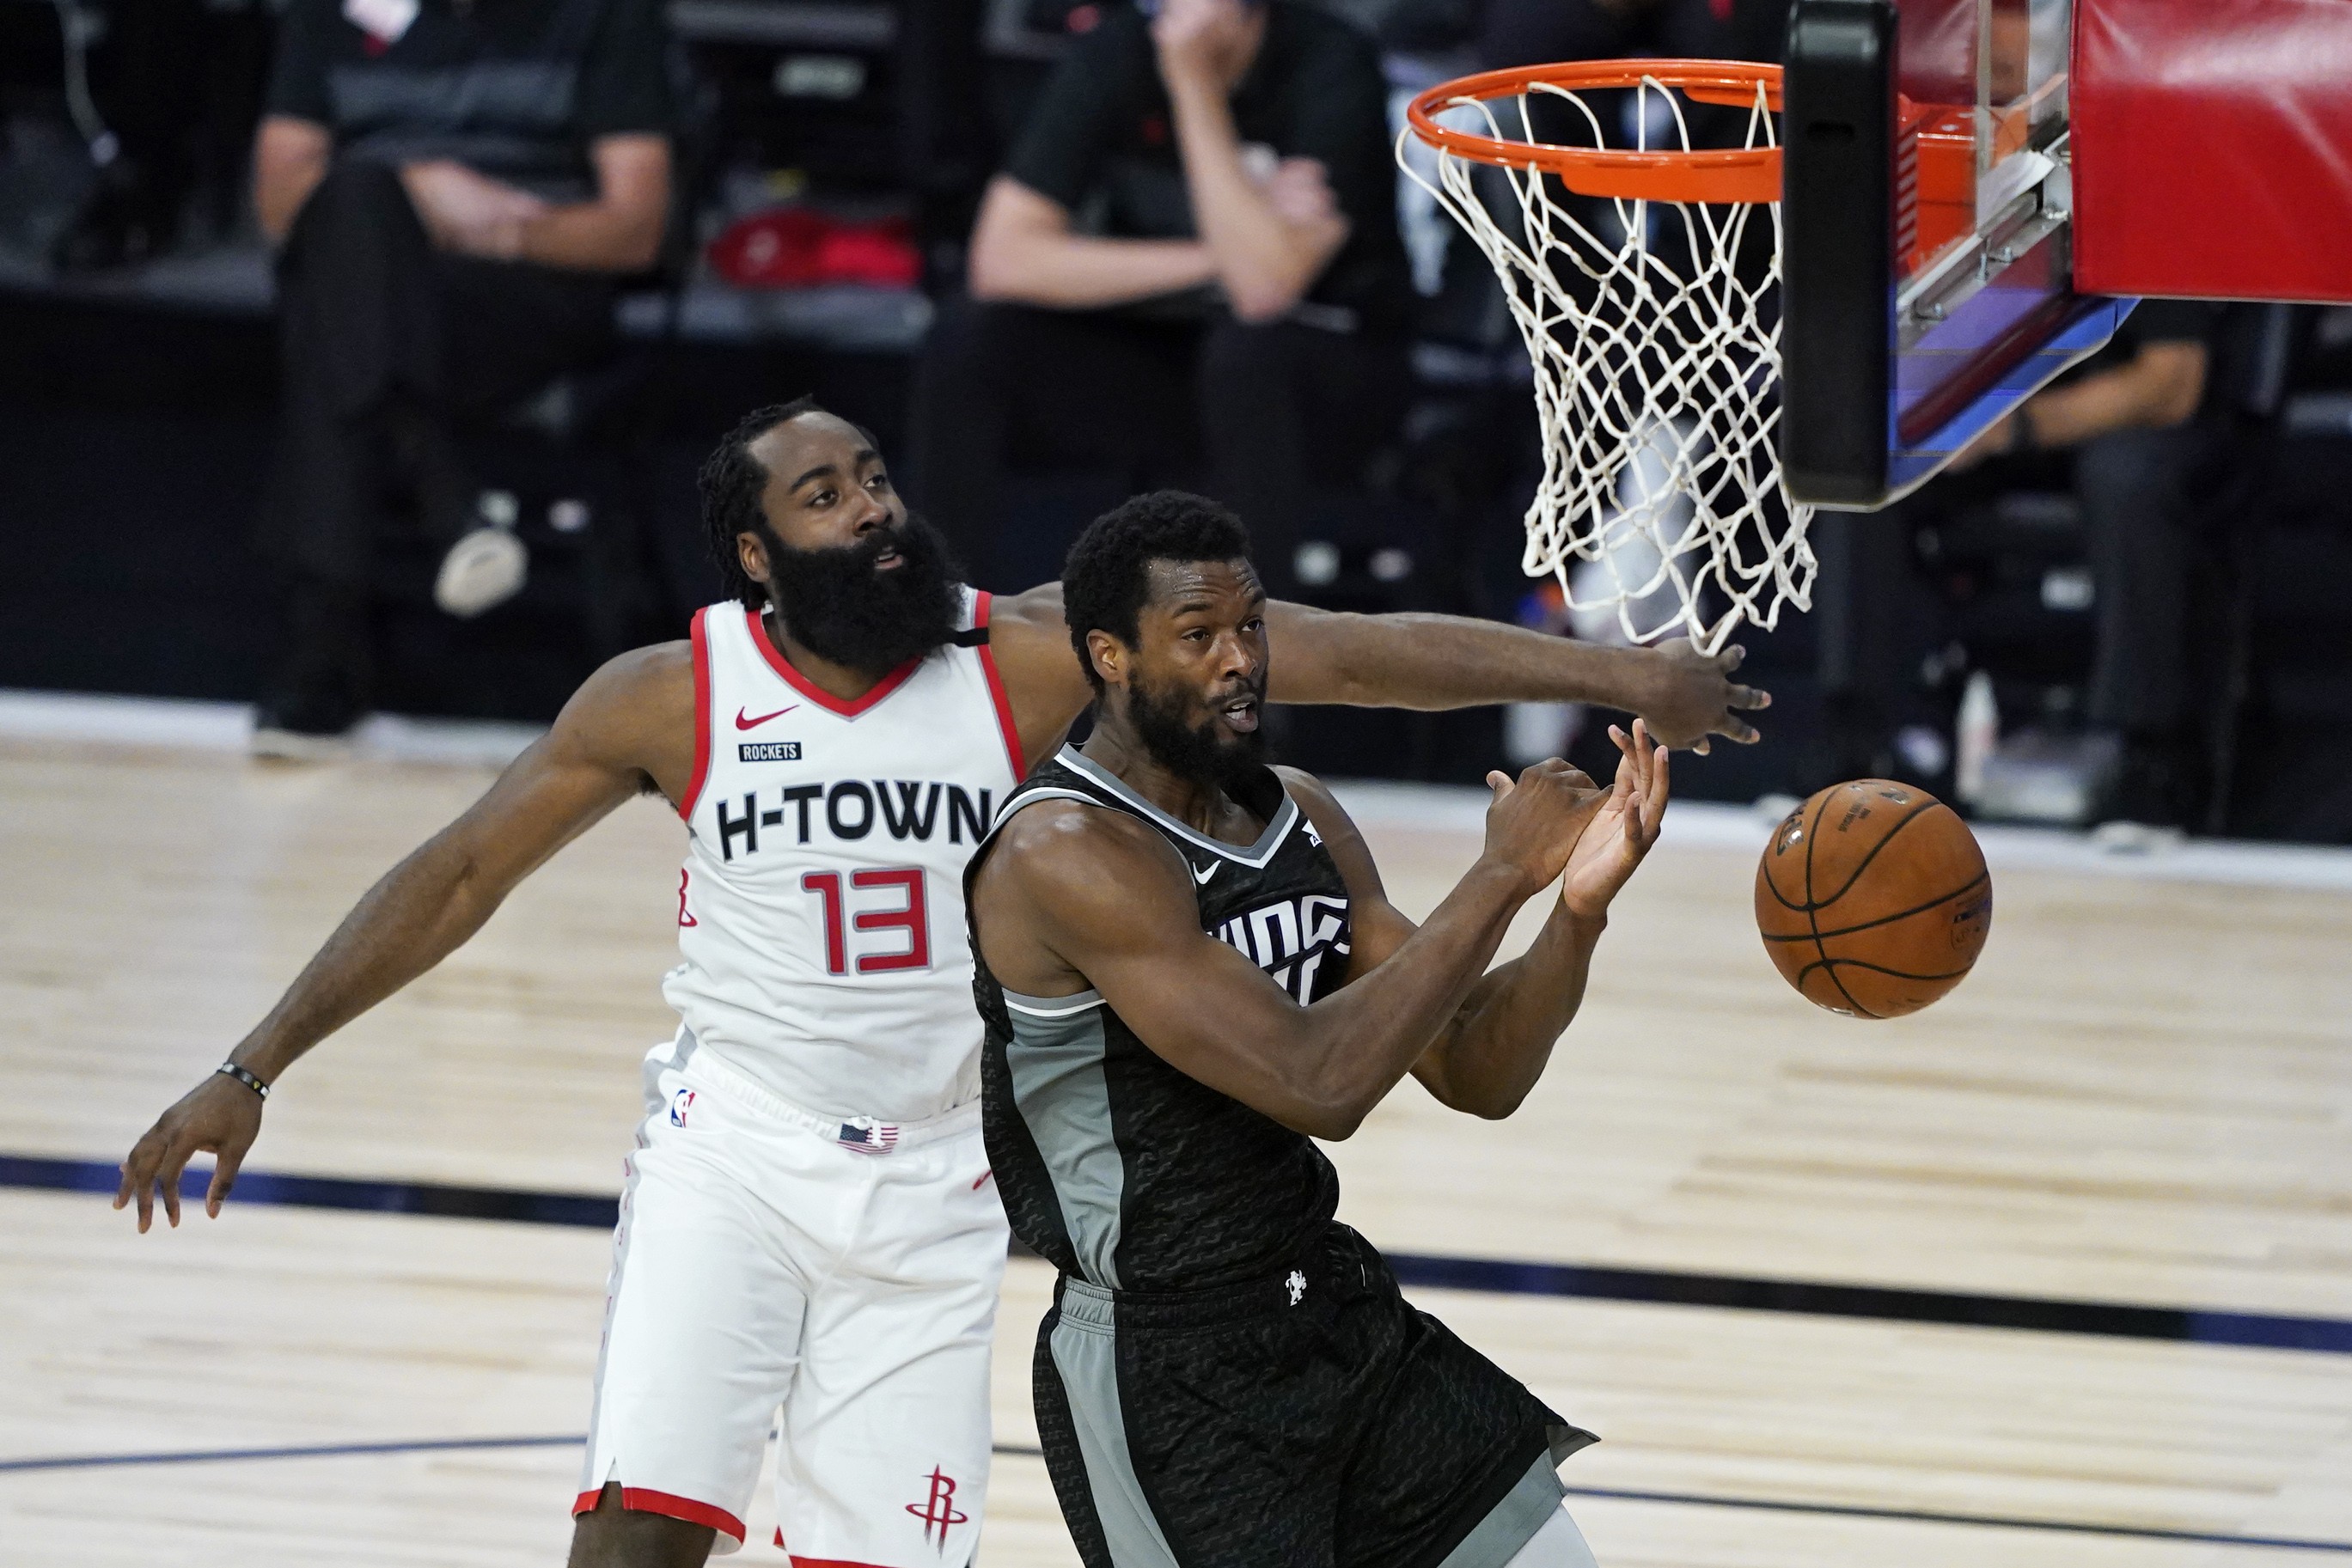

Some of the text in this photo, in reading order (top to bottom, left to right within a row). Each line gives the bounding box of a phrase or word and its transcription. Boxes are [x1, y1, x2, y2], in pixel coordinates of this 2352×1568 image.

[742, 744, 797, 760] ROCKETS
[716, 779, 993, 863] H-TOWN
[801, 866, 932, 975] 13
